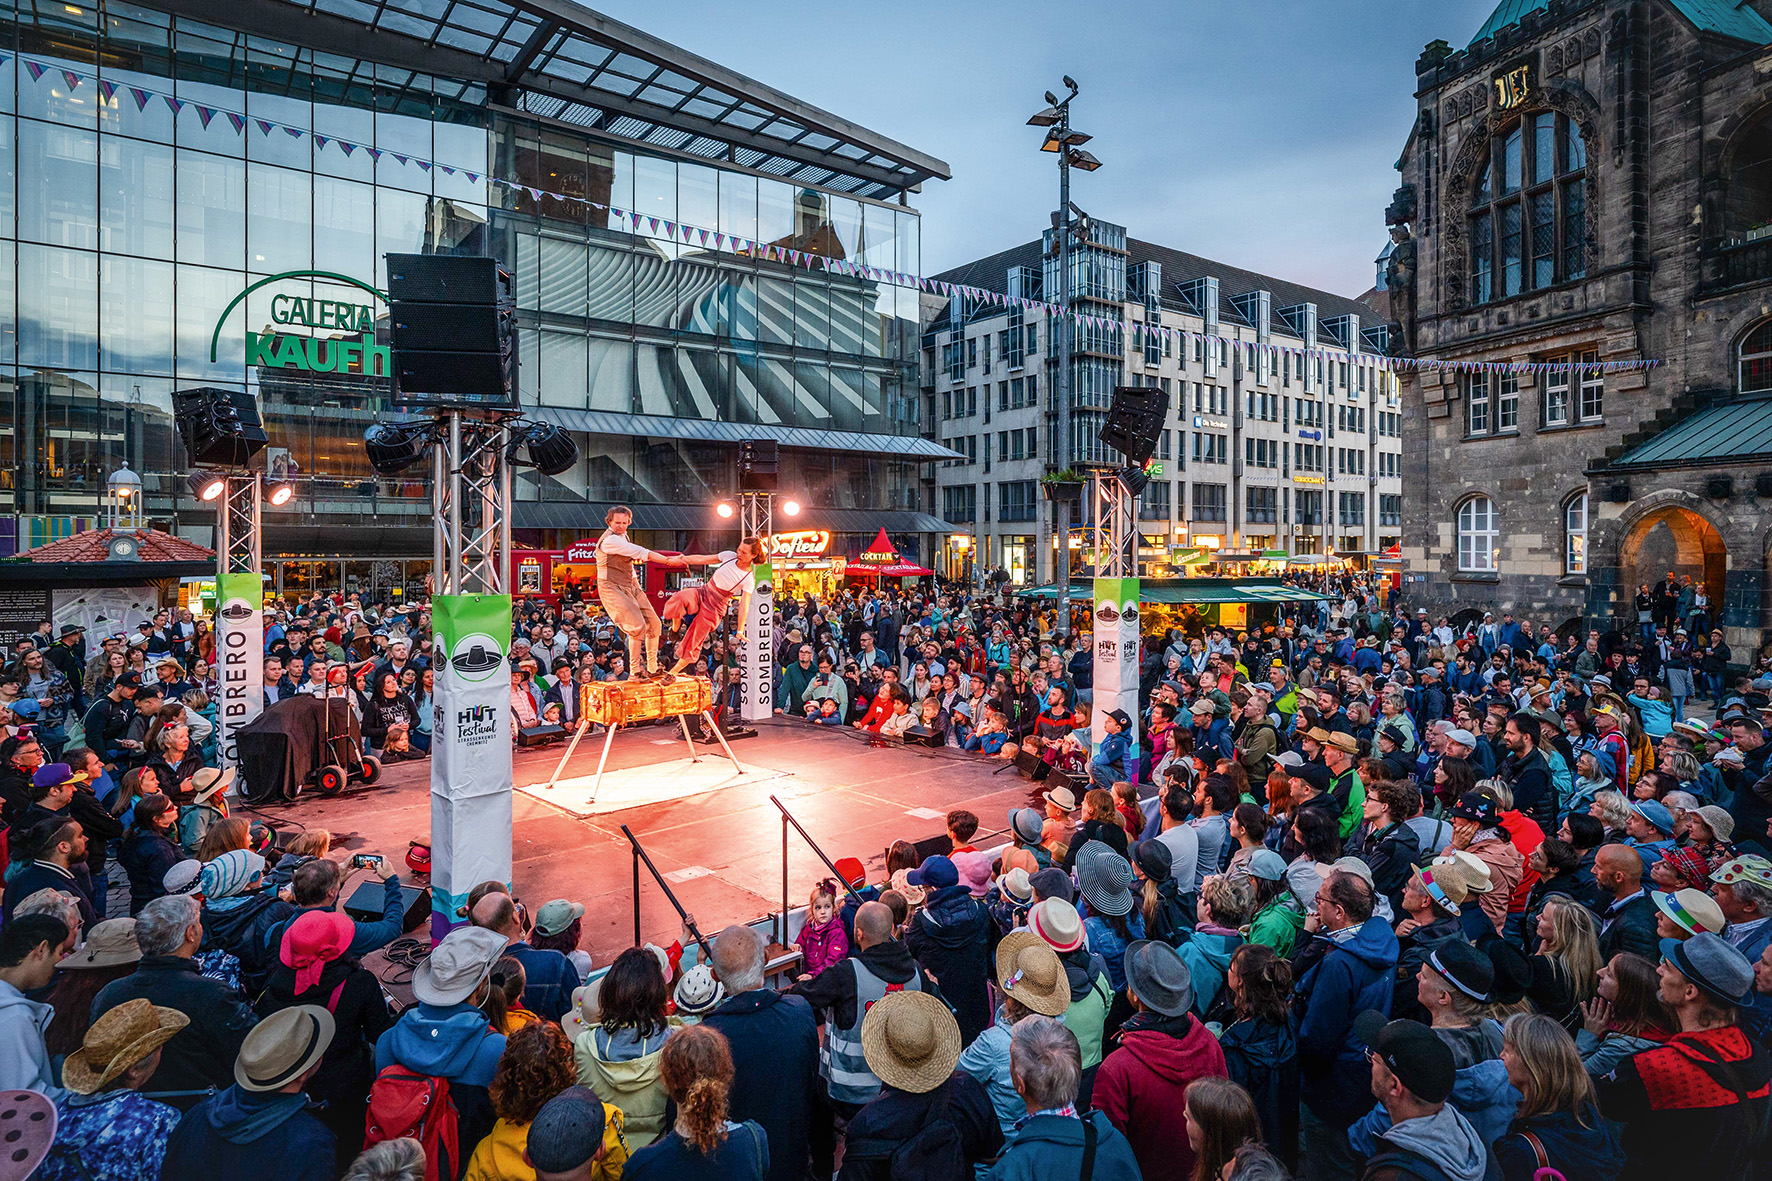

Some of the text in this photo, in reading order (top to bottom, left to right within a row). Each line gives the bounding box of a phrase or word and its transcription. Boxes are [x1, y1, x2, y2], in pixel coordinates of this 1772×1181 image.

[272, 293, 374, 332] GALERIA
[860, 552, 893, 561] COCKTAIL
[758, 602, 771, 705] SOMBRERO
[457, 704, 497, 724] HUT
[457, 719, 497, 738] Festival
[457, 734, 497, 743] STRASSENKUNST
